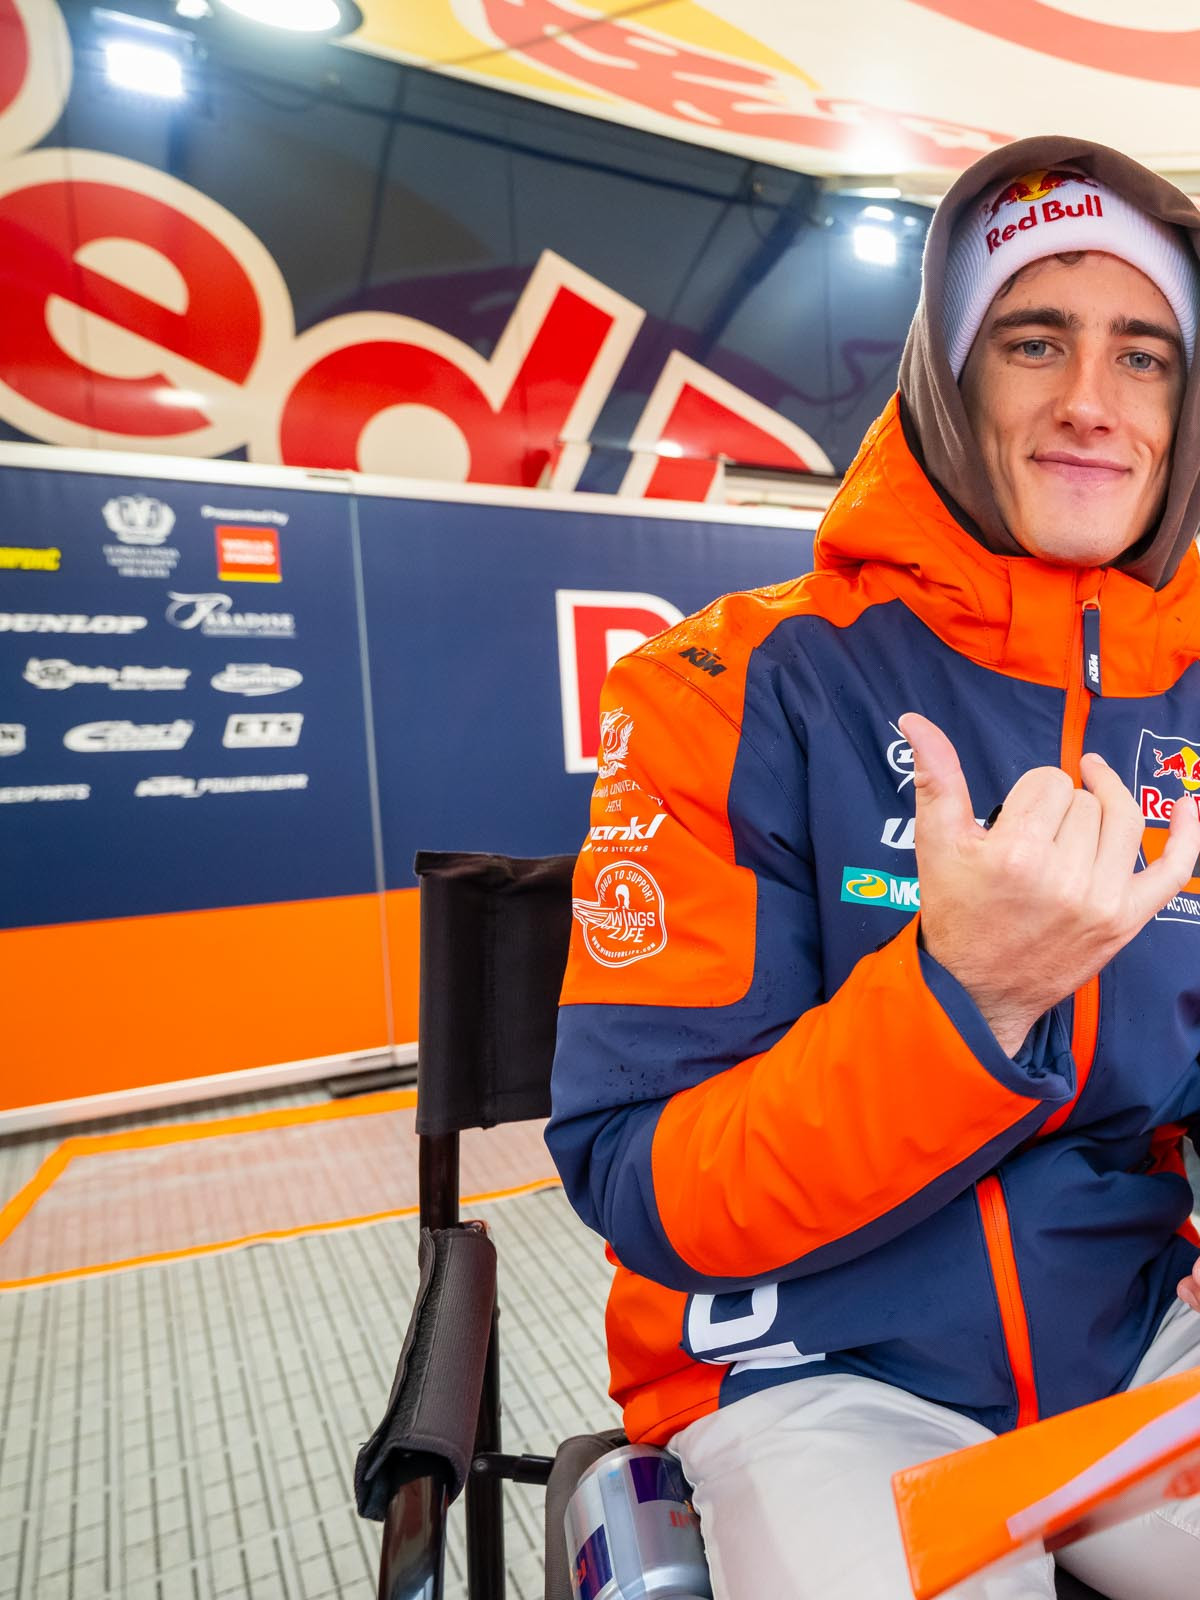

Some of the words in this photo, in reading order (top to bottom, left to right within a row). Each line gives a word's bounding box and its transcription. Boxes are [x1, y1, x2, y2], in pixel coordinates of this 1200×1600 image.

[985, 206, 1038, 256] Red
[1042, 194, 1103, 223] Bull
[0, 613, 148, 635] DUNLOP
[677, 645, 728, 677] KTM
[1088, 653, 1100, 684] KTM
[233, 719, 294, 736] ETS
[1141, 786, 1190, 820] Re
[614, 869, 626, 881] TO
[626, 869, 656, 904] SUPPORT
[608, 911, 656, 928] WINGS
